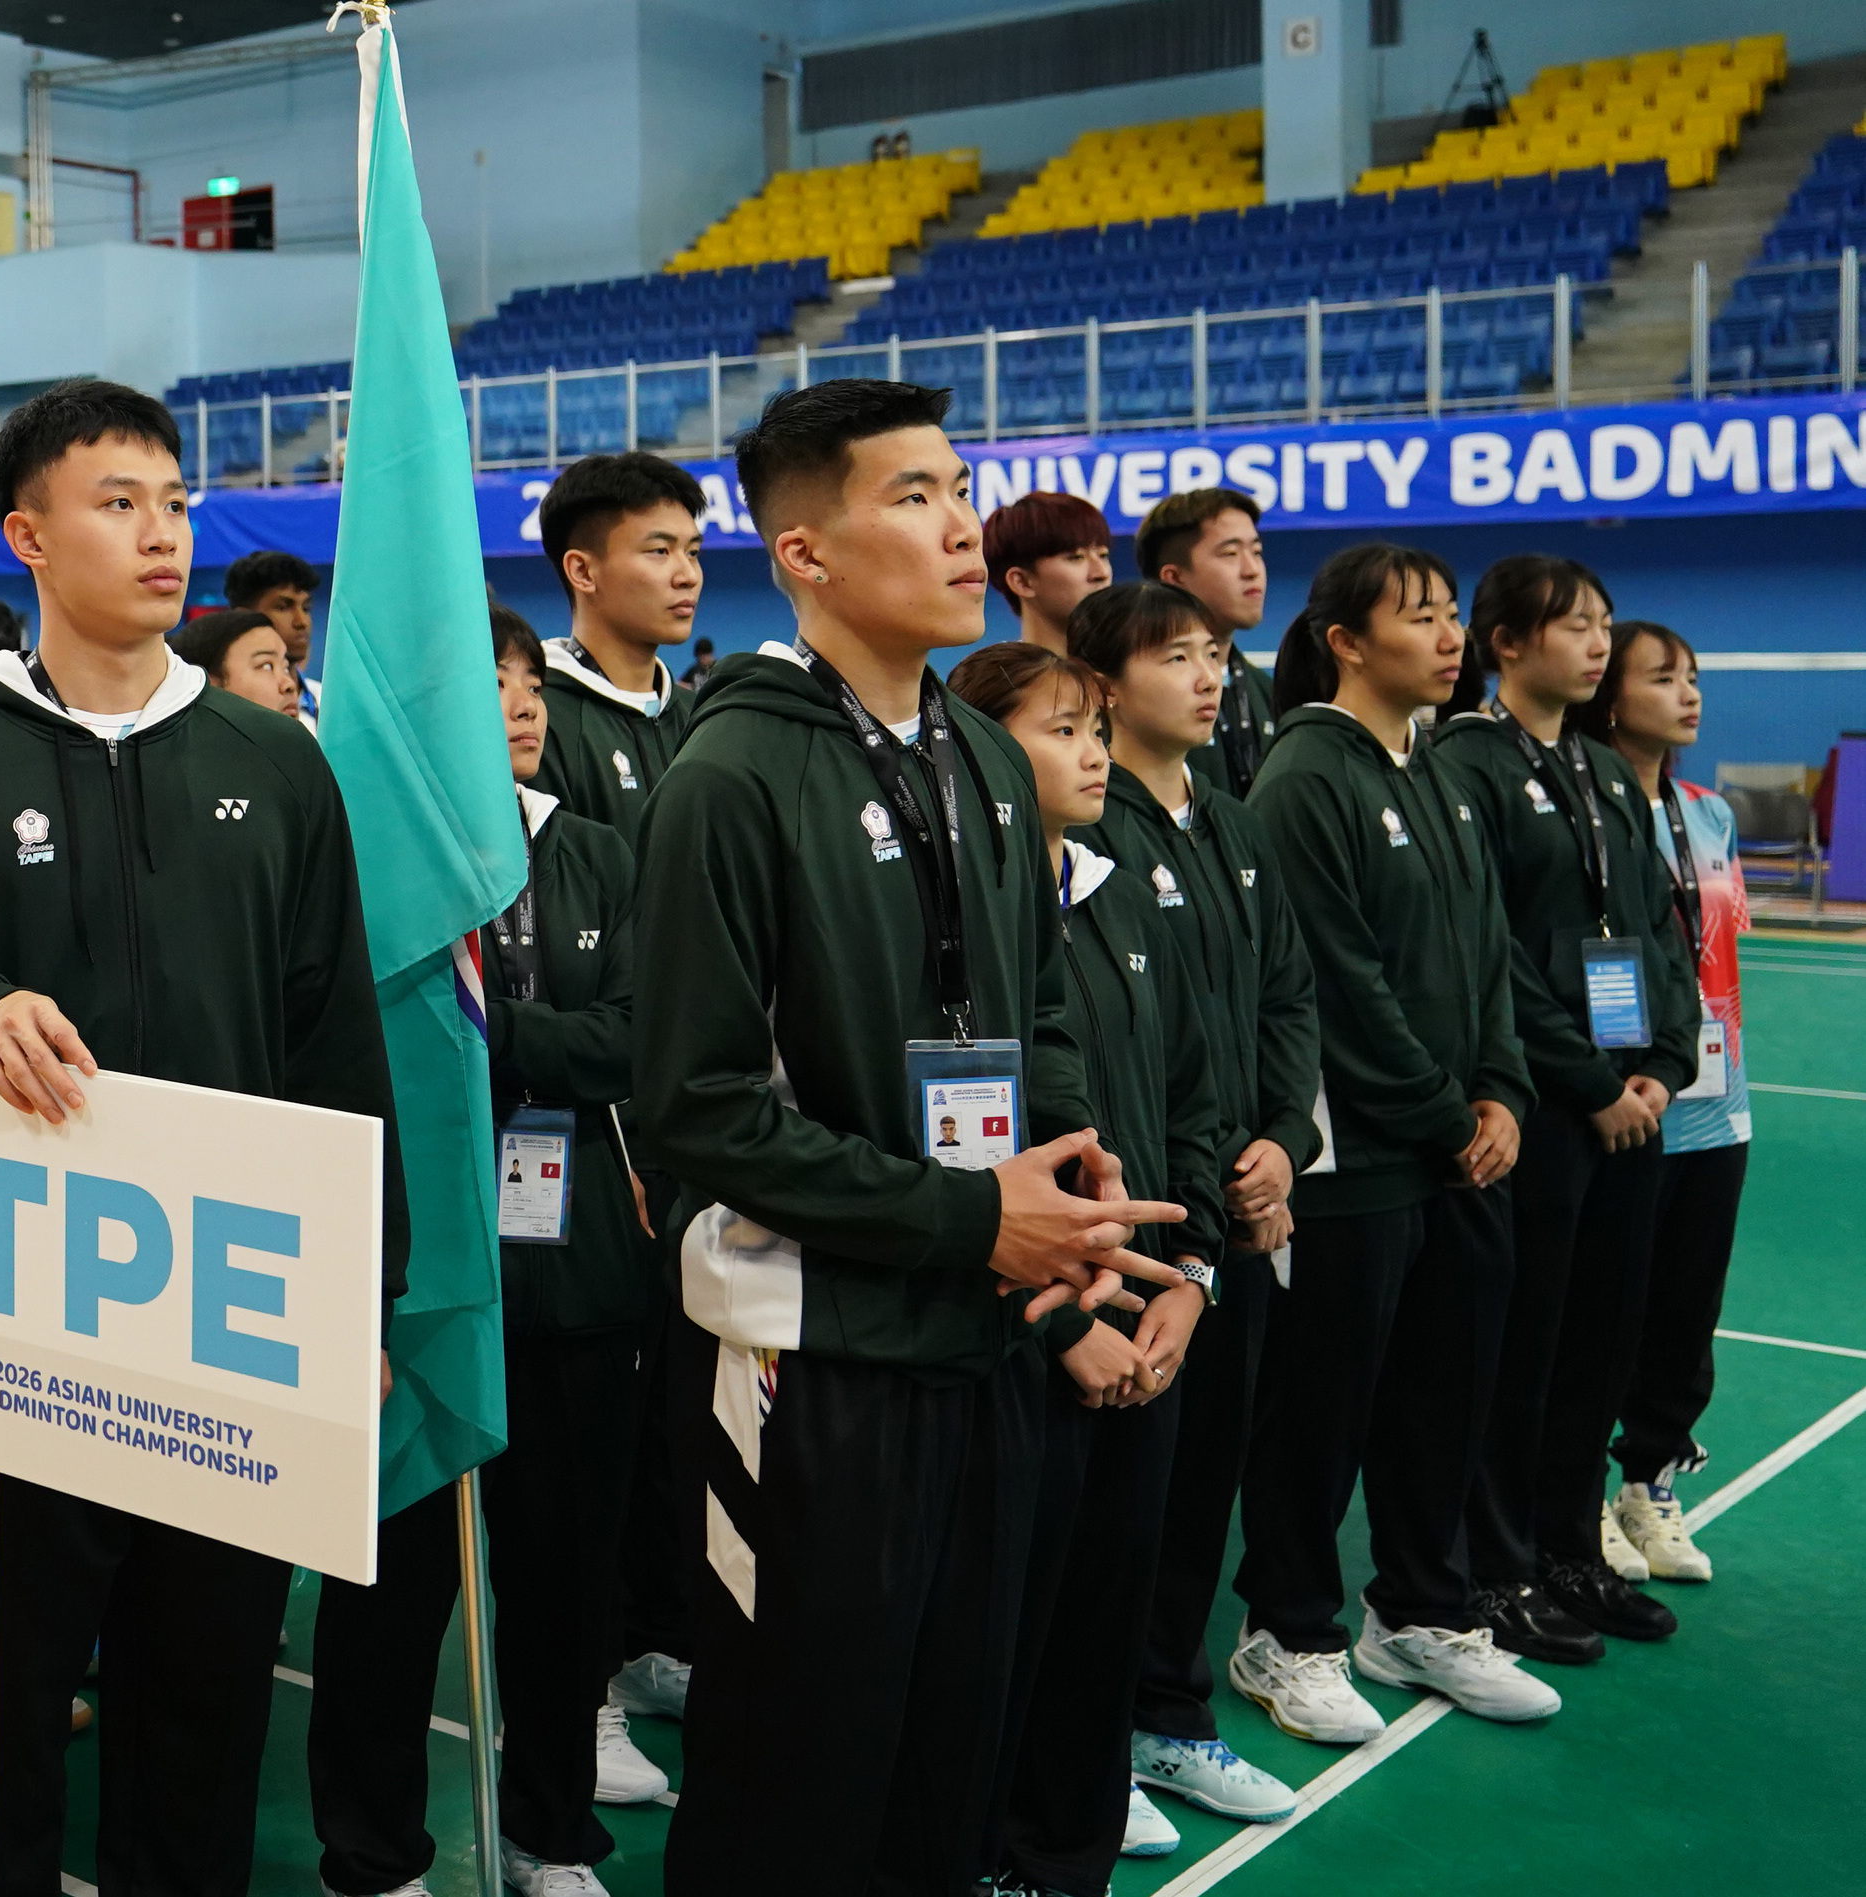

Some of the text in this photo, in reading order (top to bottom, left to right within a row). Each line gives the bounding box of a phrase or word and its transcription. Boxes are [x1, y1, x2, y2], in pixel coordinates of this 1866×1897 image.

[969, 437, 1429, 518] NIVERSITY
[18, 851, 54, 866] TAIPEI
[47, 1376, 111, 1411] ASIAN
[117, 1394, 253, 1449] UNIVERSITY
[102, 1419, 278, 1486] CHAMPIONSHIP
